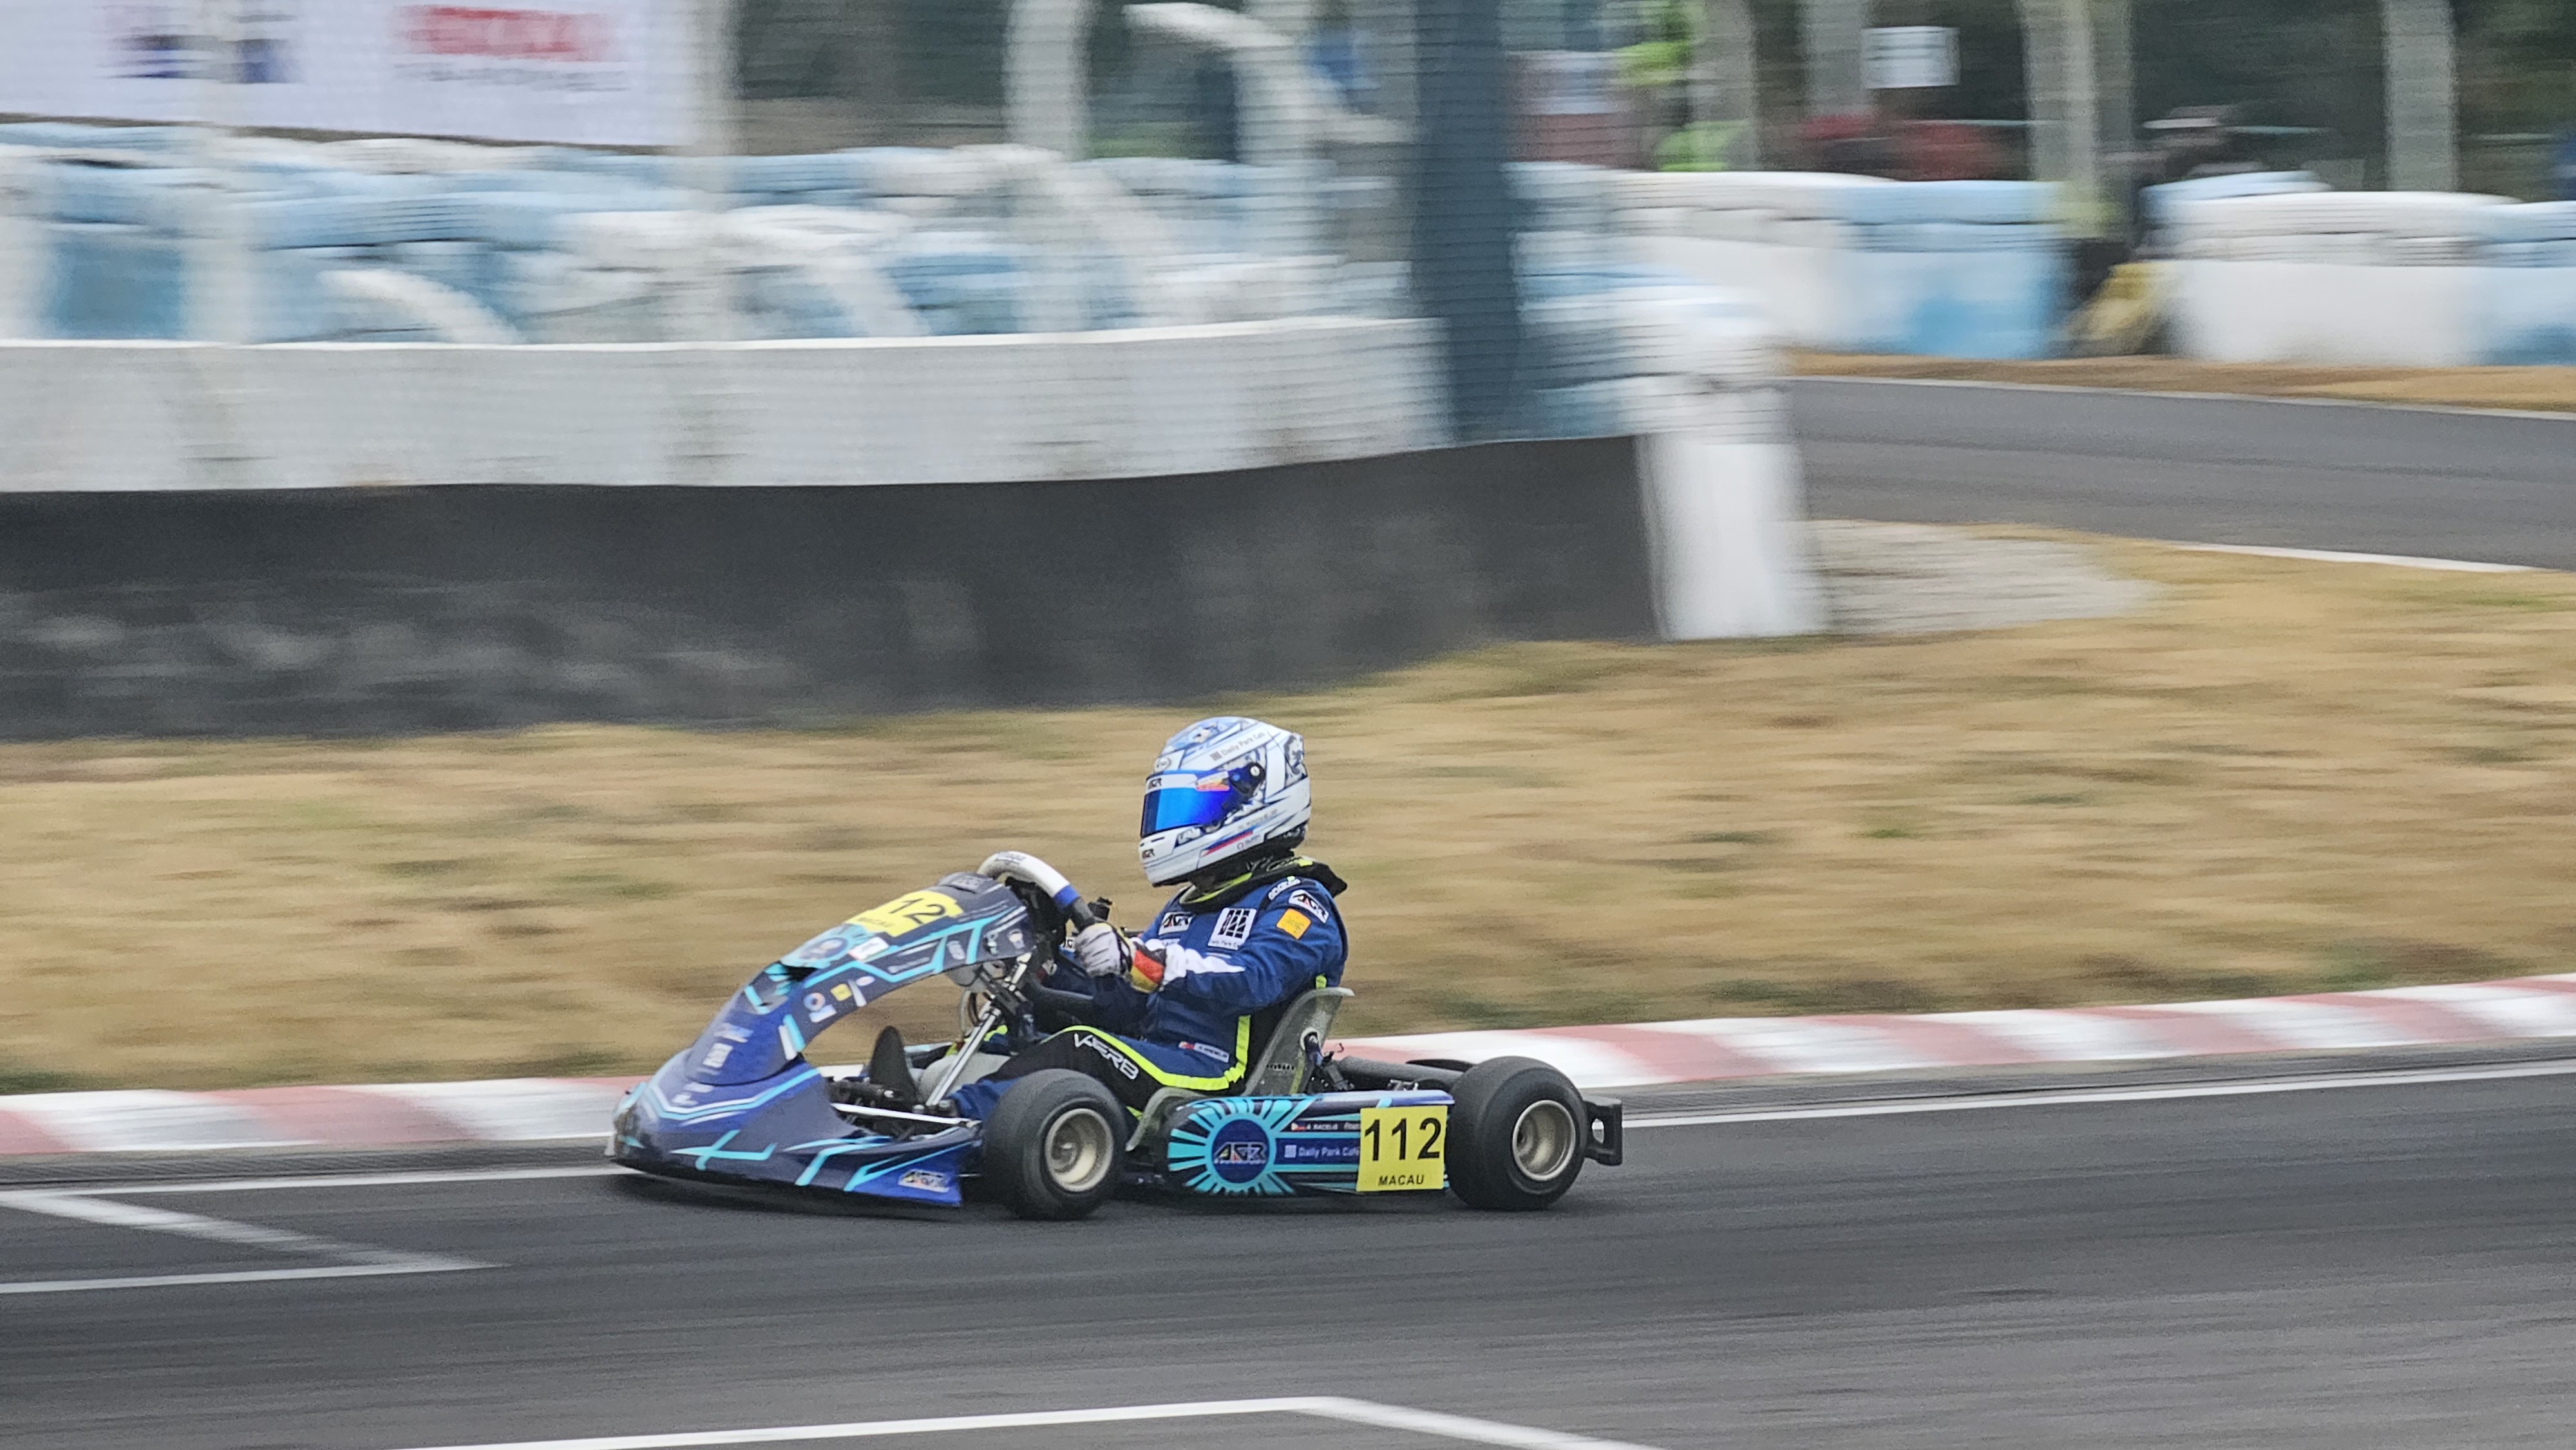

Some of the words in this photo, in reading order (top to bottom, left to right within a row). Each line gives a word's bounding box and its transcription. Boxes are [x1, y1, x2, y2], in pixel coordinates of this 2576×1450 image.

[1364, 1117, 1442, 1162] 112
[1298, 1147, 1320, 1158] Daily
[1321, 1147, 1340, 1157] Park
[1378, 1174, 1425, 1186] MACAU
